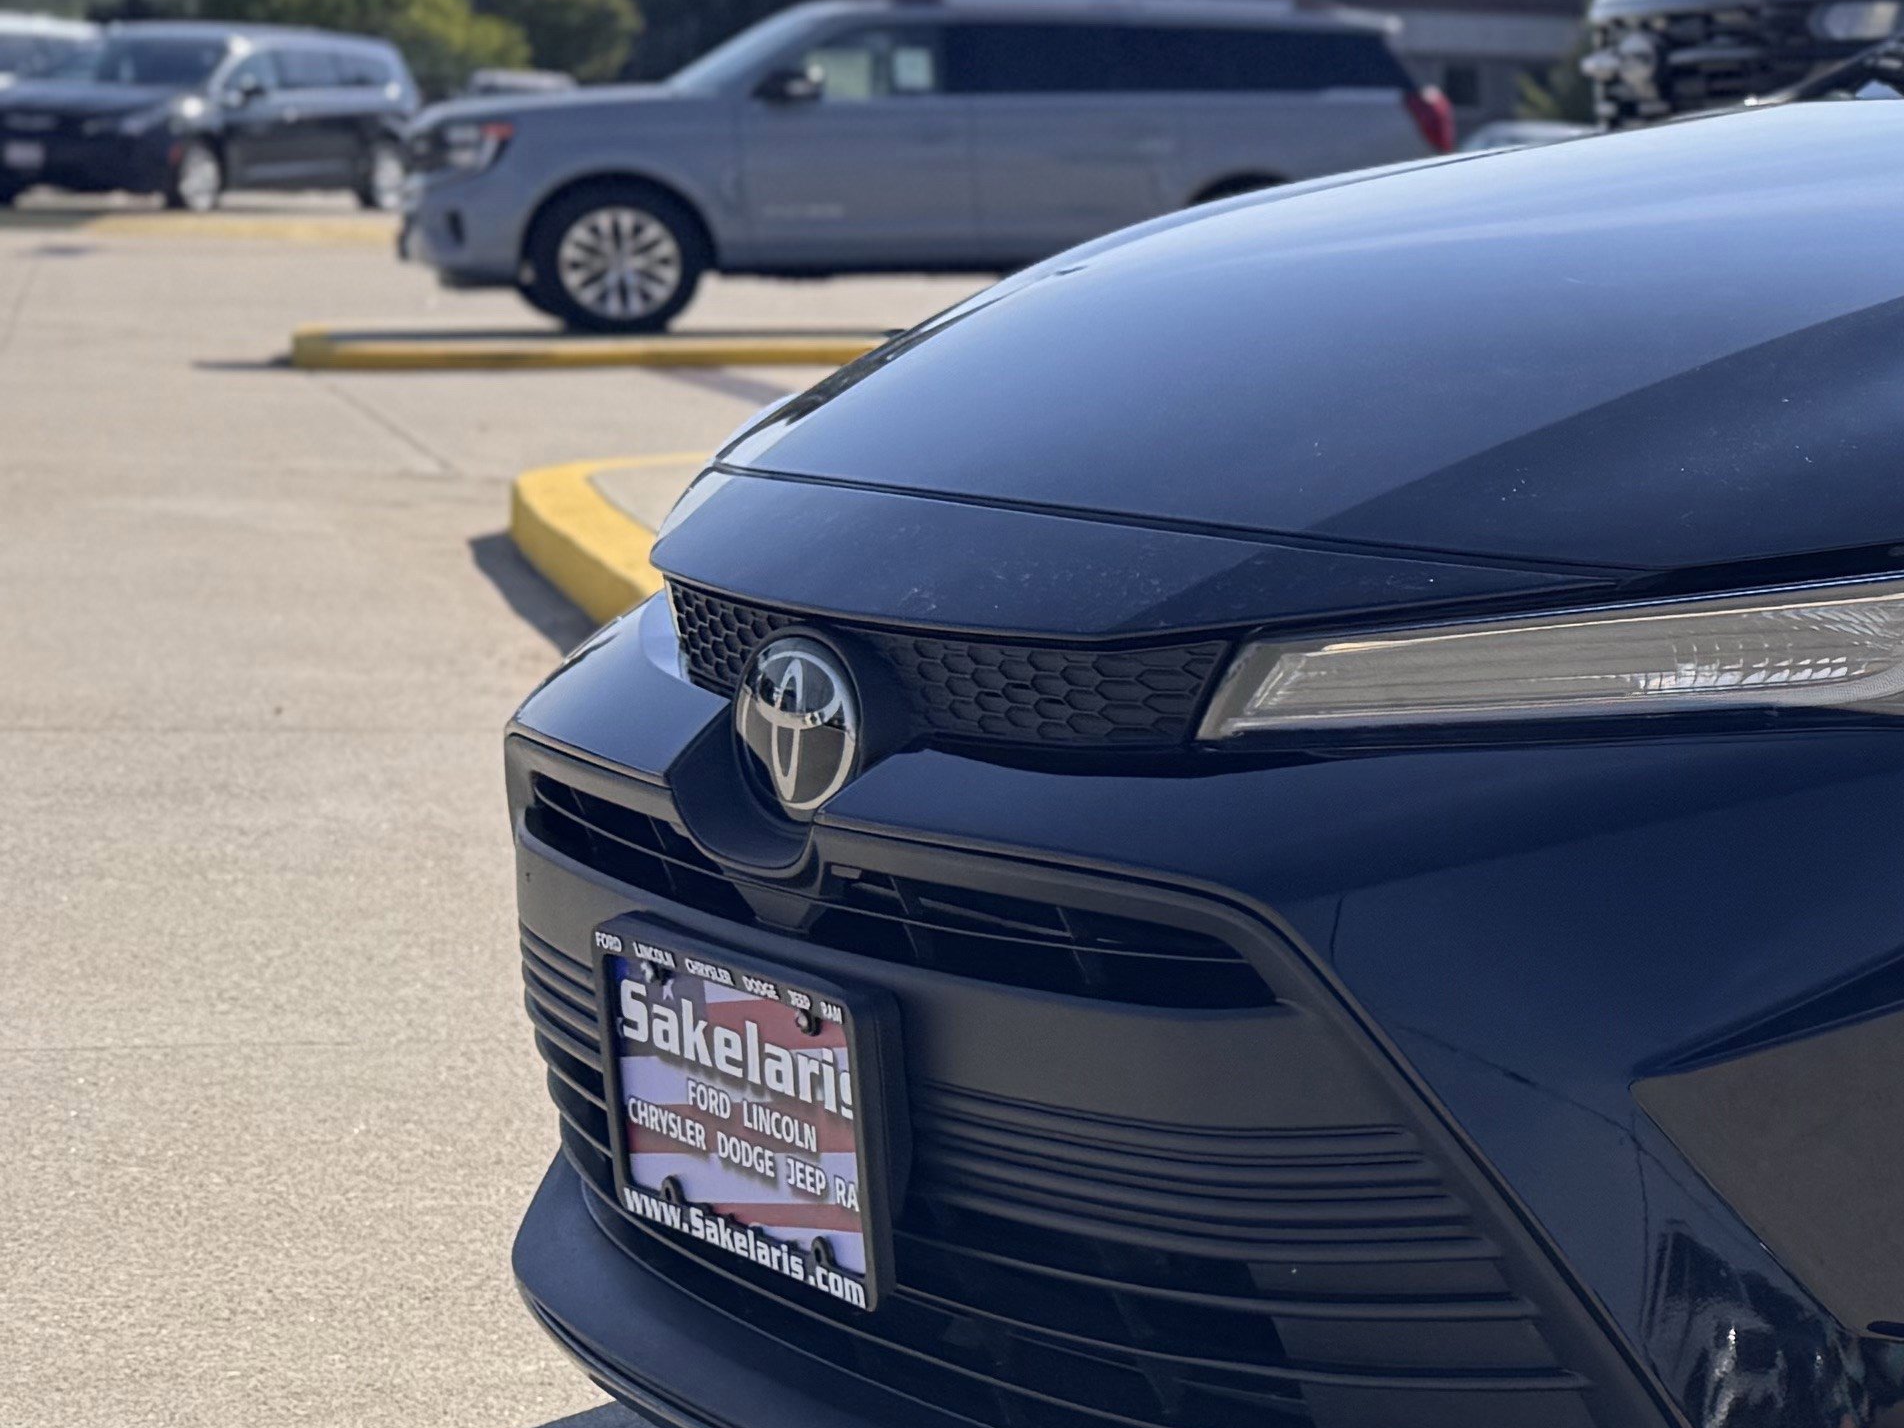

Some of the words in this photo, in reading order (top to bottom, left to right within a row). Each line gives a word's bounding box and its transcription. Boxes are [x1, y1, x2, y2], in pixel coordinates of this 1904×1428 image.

[595, 931, 622, 952] FORD
[632, 941, 676, 968] LINCOLN
[685, 957, 735, 986] CHRYSLER
[628, 1097, 706, 1150] CHRYSLER
[717, 1131, 775, 1178] DODGE
[786, 1157, 826, 1196] JEEP
[687, 1078, 731, 1119] FORD
[743, 1098, 817, 1152] LINCOLN
[623, 1187, 867, 1309] www.Sakelaris.com
